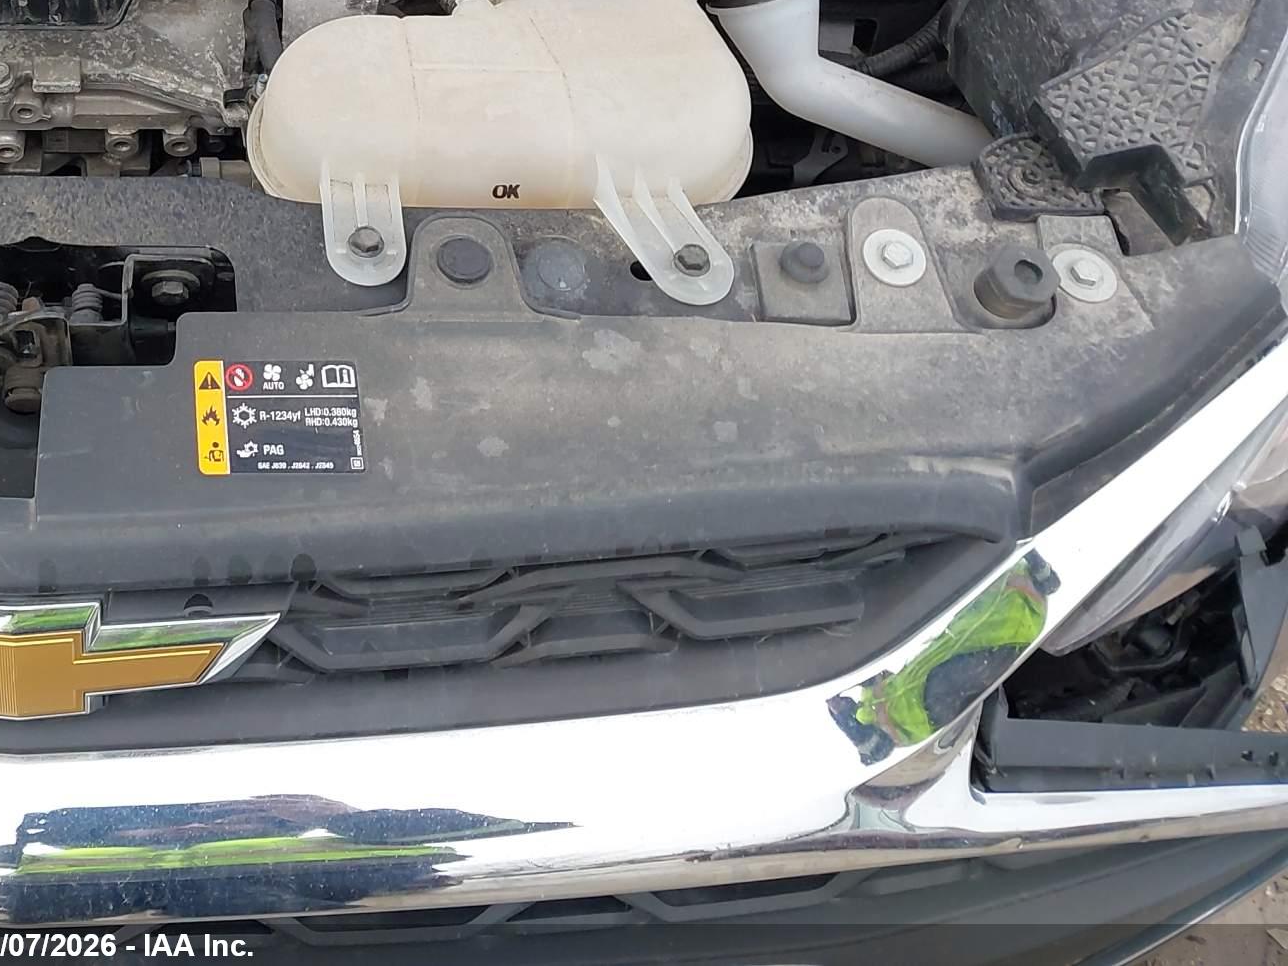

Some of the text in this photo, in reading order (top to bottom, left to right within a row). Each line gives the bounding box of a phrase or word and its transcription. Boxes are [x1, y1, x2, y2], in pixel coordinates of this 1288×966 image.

[492, 184, 521, 199] OK
[263, 382, 285, 390] AUTO
[259, 411, 302, 422] R-1234yf
[305, 417, 359, 428] RHD:0.430kg
[263, 444, 285, 455] PAG
